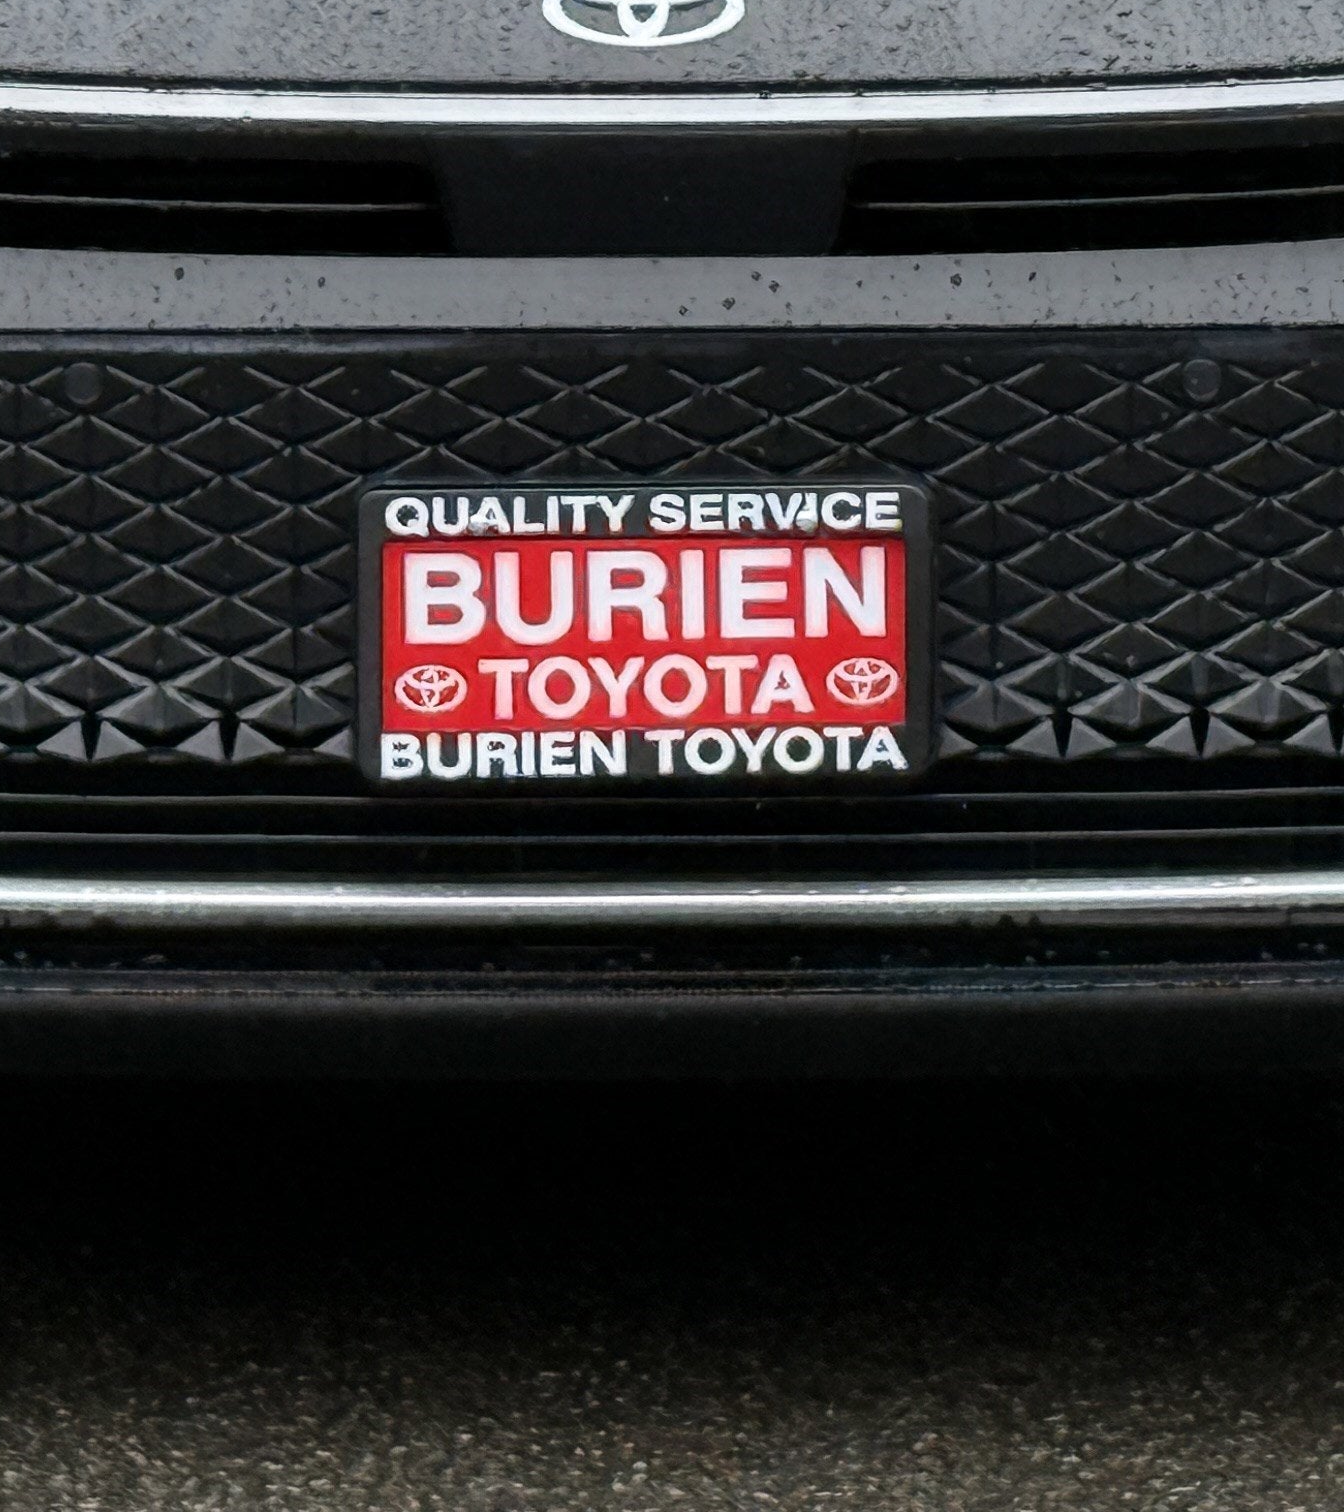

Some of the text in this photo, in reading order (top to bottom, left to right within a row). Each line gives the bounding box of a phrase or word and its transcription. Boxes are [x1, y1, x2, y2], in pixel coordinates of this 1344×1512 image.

[385, 491, 903, 537] QUALITY SERVICE
[403, 545, 888, 645] BURIEN
[477, 653, 815, 720] TOYOTA
[380, 726, 909, 780] BURIEN TOYOTA
